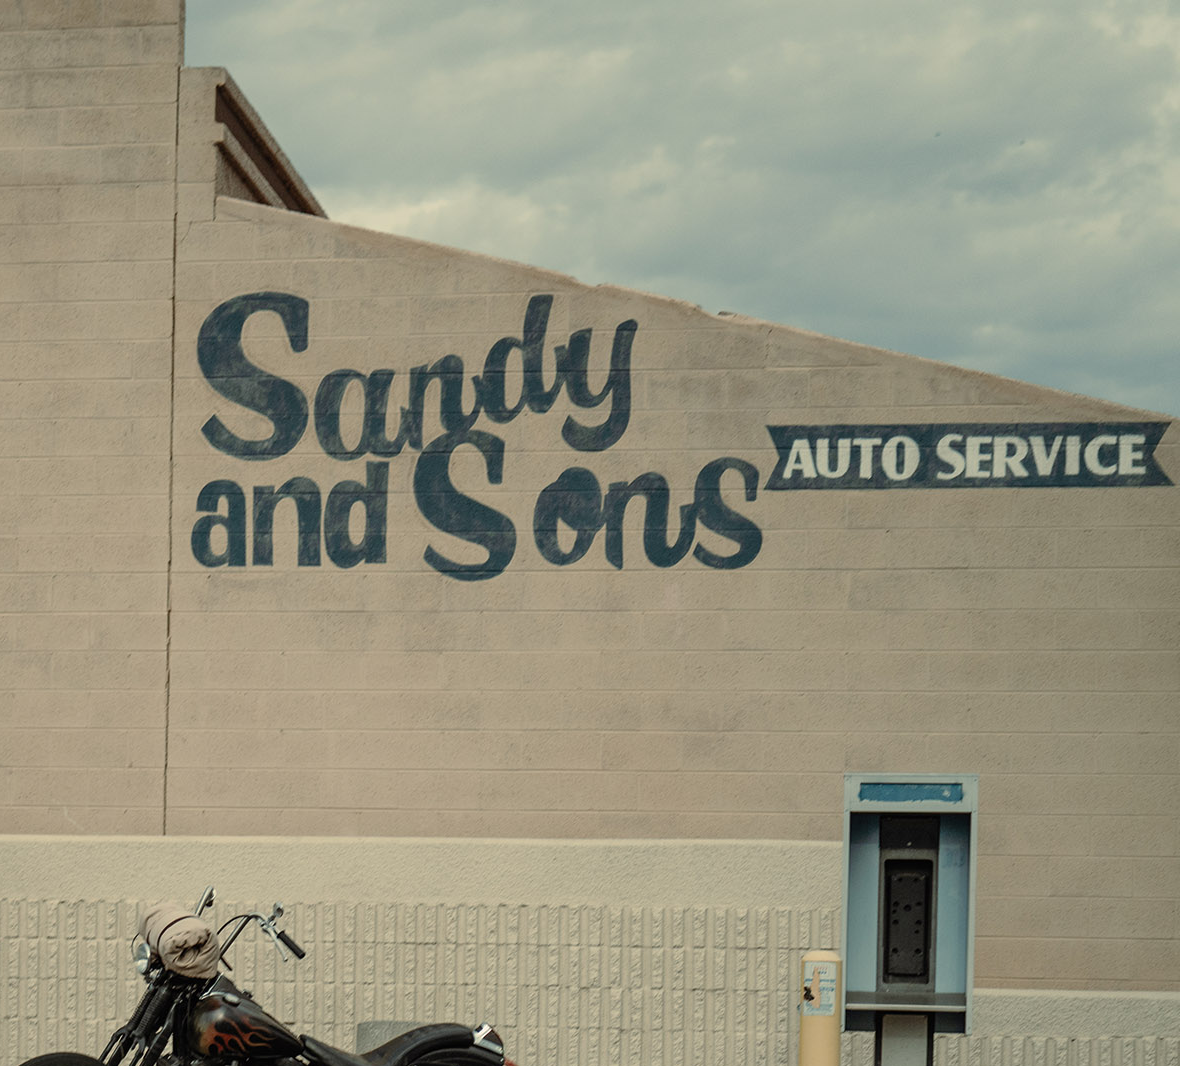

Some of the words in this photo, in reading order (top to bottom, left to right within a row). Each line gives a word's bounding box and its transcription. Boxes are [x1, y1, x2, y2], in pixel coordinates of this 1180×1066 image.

[197, 291, 638, 461] Sandy
[191, 461, 389, 569] and
[414, 430, 762, 581] Sons
[782, 435, 919, 482] AUTO
[936, 434, 1146, 480] SERVICE
